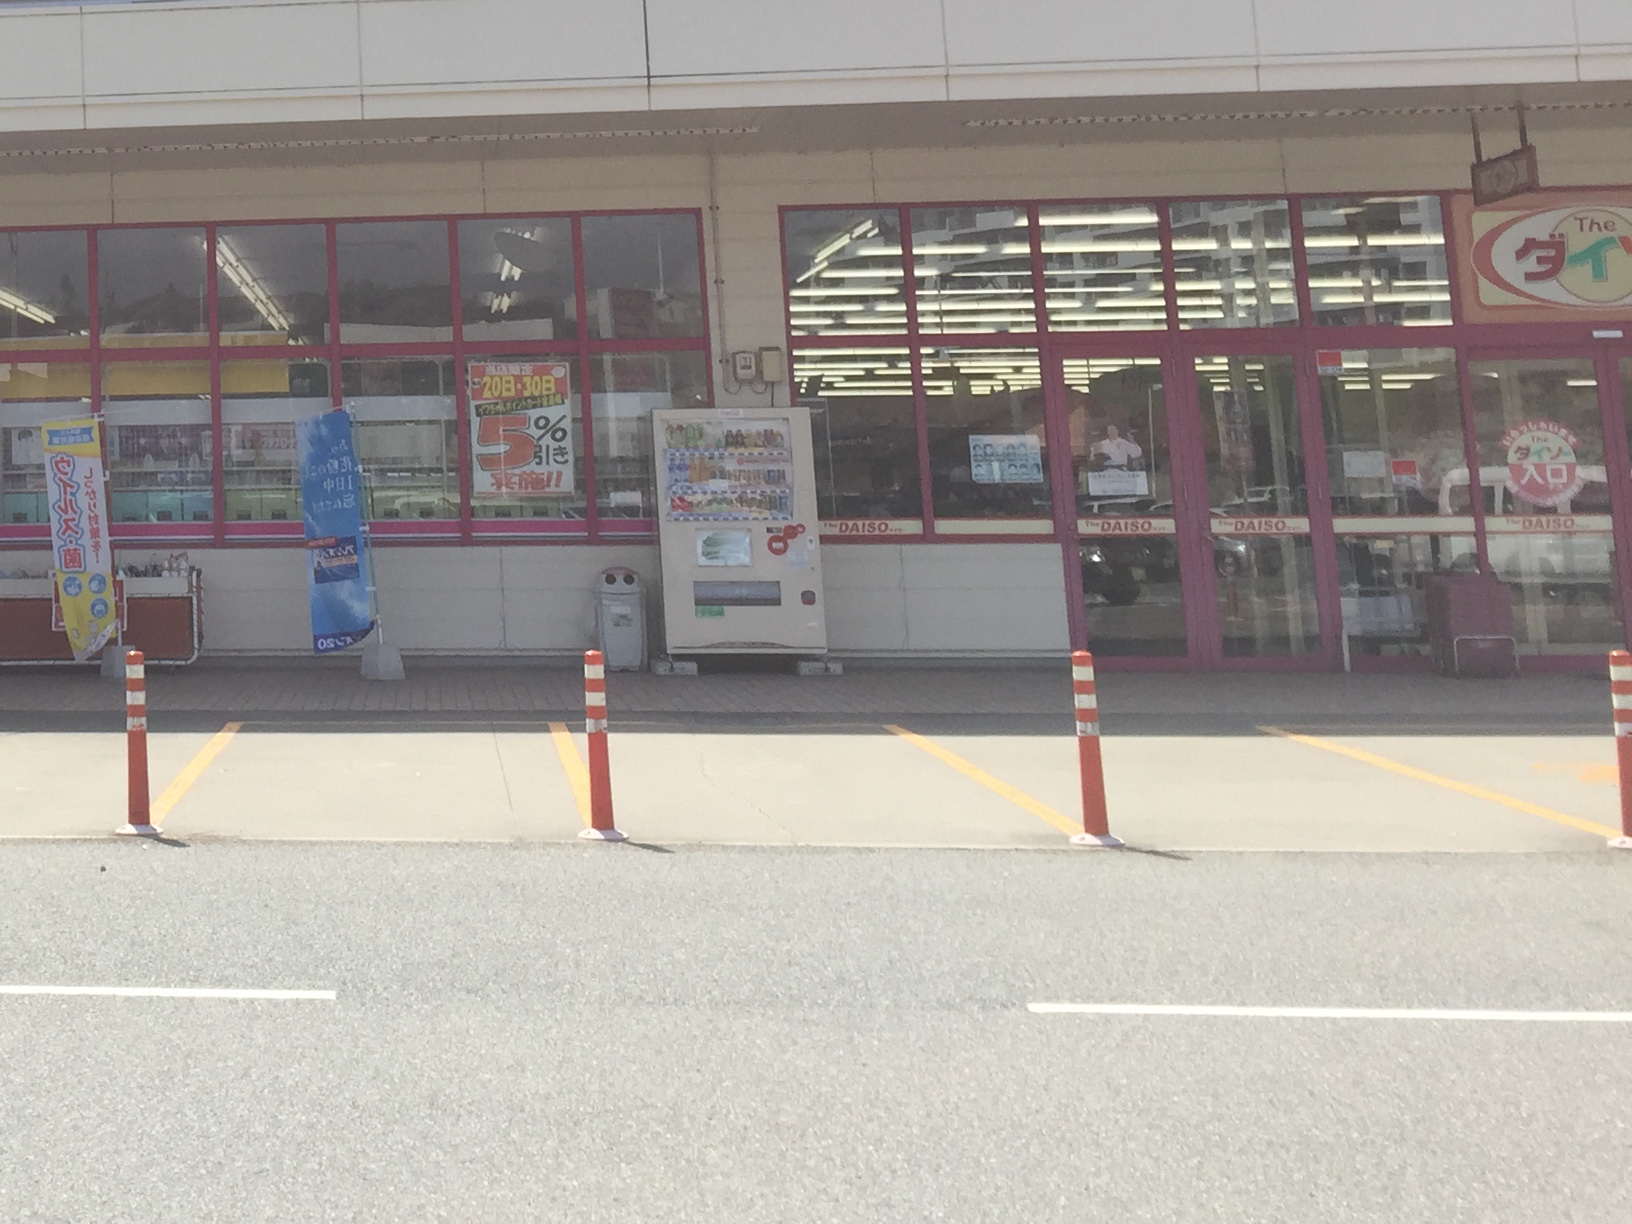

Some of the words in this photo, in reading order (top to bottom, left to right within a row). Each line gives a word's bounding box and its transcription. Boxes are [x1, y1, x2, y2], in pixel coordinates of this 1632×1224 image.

[1574, 216, 1617, 234] The
[1520, 462, 1568, 486] 入口
[838, 521, 890, 534] DAISO
[1100, 519, 1153, 533] DAISO
[1234, 518, 1286, 533] DAISO
